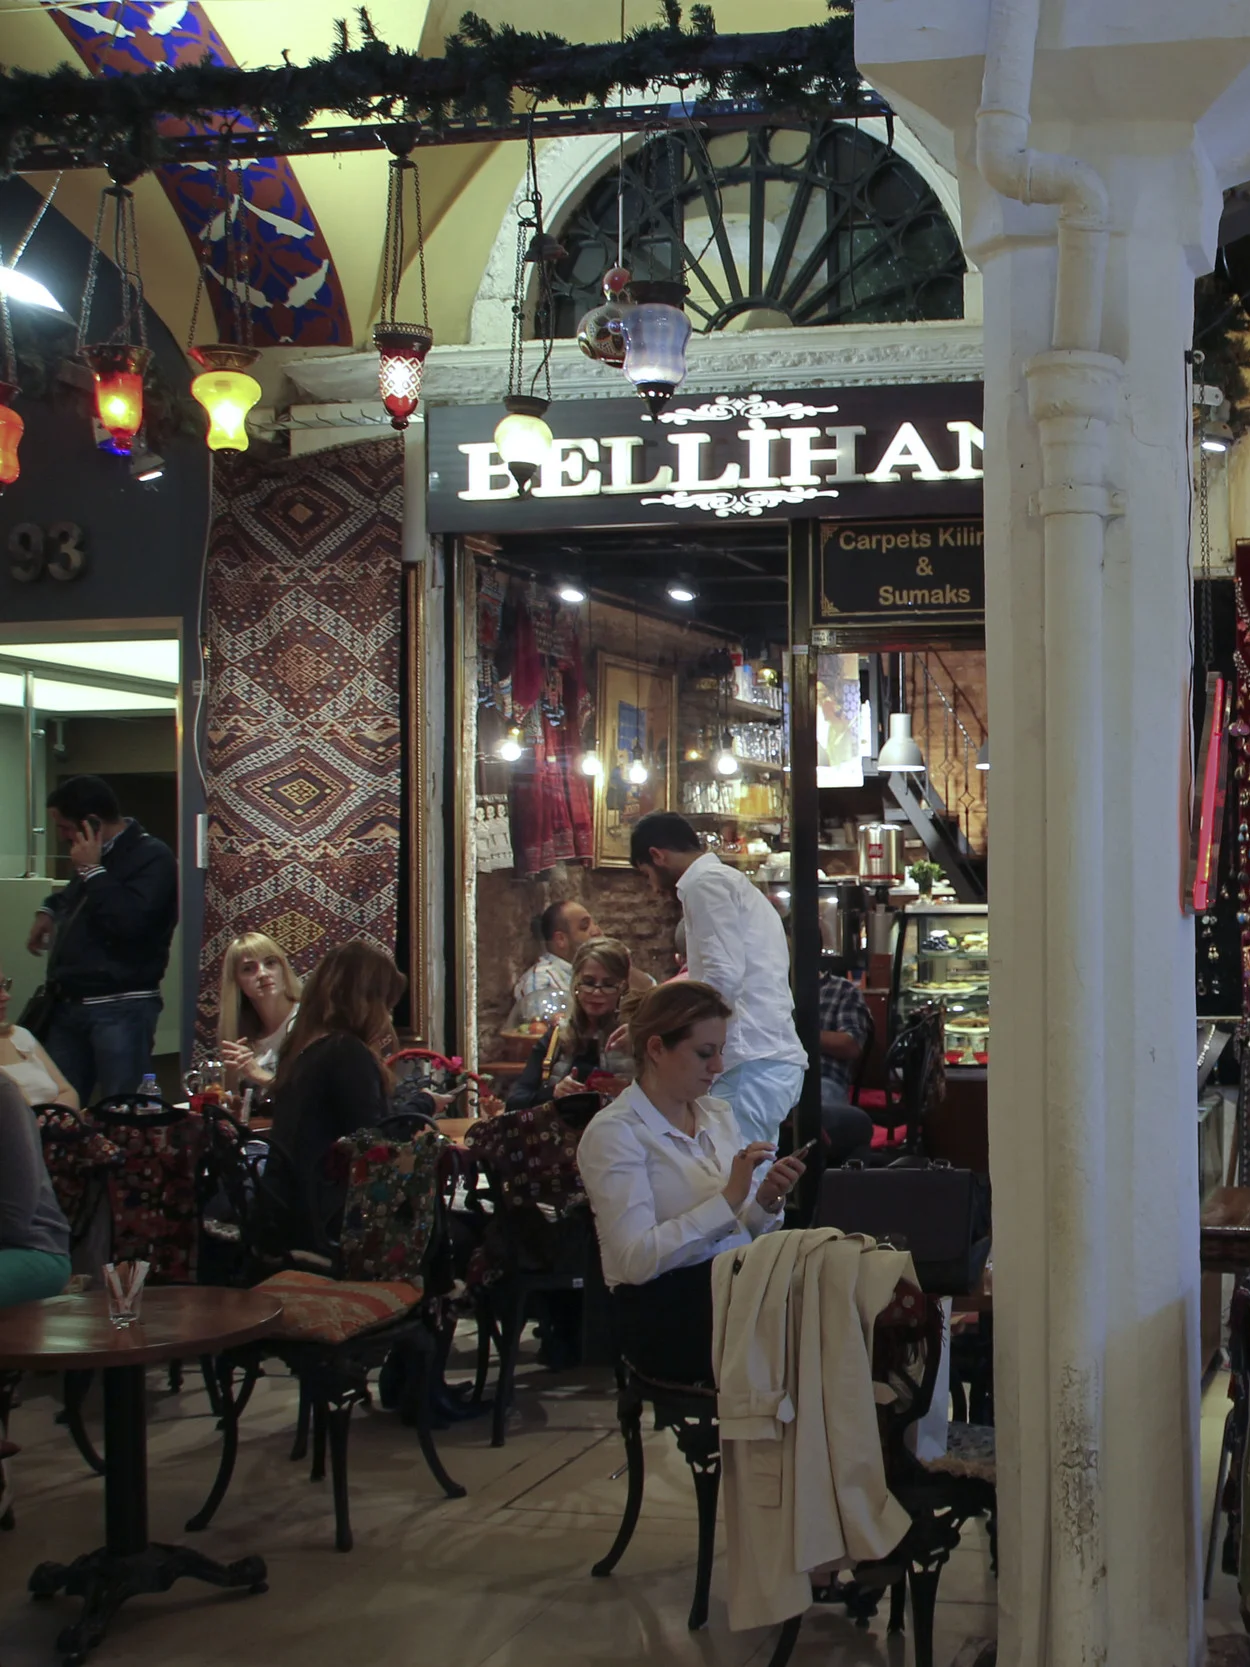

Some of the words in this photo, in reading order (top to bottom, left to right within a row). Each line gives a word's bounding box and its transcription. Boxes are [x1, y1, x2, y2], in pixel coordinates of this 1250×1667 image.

[8, 521, 86, 583] 93
[839, 529, 931, 553] Carpets
[938, 527, 984, 547] Kili
[916, 556, 933, 576] &
[878, 584, 971, 606] Sumaks
